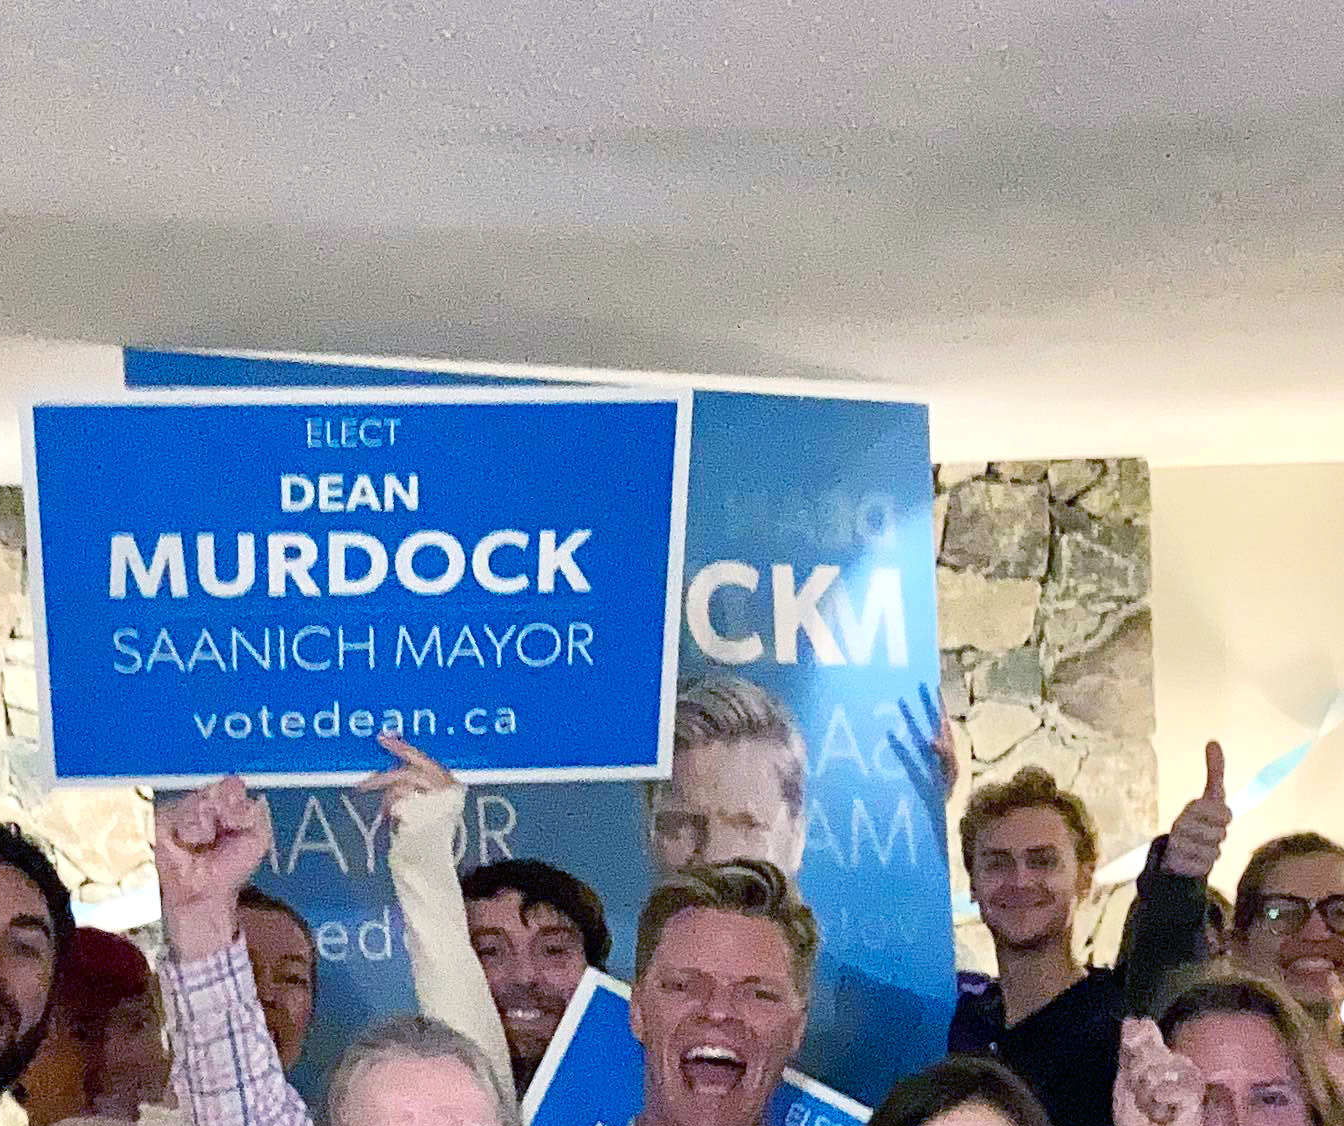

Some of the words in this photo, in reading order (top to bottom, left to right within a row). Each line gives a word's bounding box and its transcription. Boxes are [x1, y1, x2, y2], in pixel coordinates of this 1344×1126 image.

[306, 417, 399, 450] ELECT
[280, 473, 419, 513] DEAN
[109, 529, 593, 600] MURDOCK
[113, 625, 375, 674] SAANICH
[396, 624, 594, 670] MAYOR
[193, 701, 518, 740] votedean.ca
[260, 794, 518, 876] AYR
